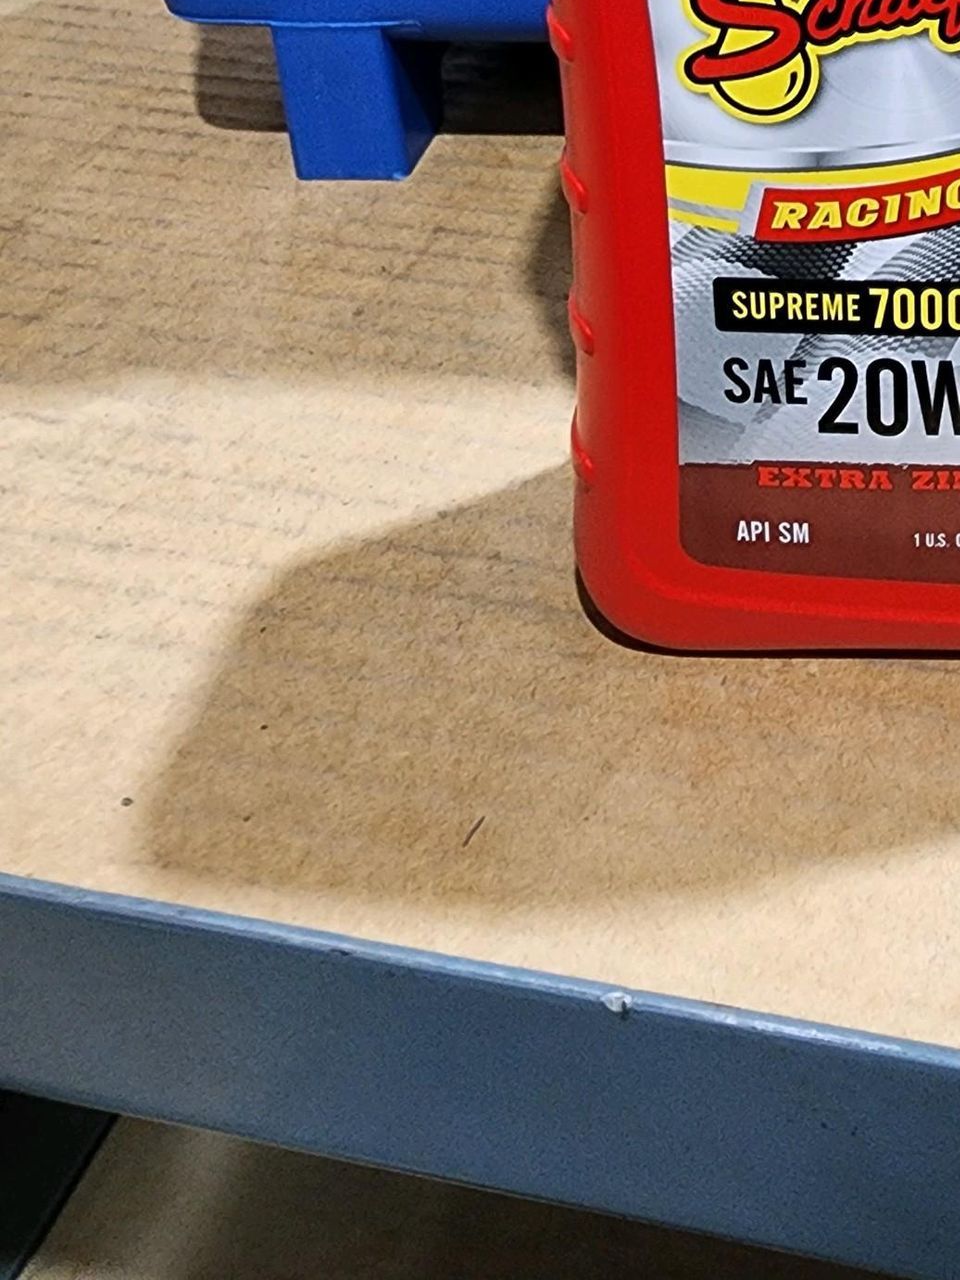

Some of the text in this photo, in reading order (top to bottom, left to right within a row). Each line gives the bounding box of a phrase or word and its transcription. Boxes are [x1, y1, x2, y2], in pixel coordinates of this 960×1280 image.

[732, 290, 861, 321] SUPREME
[722, 357, 809, 405] SAE
[757, 466, 893, 491] EXTRA
[736, 520, 810, 544] API SM
[913, 532, 921, 548] 1
[925, 532, 950, 548] U.S.
